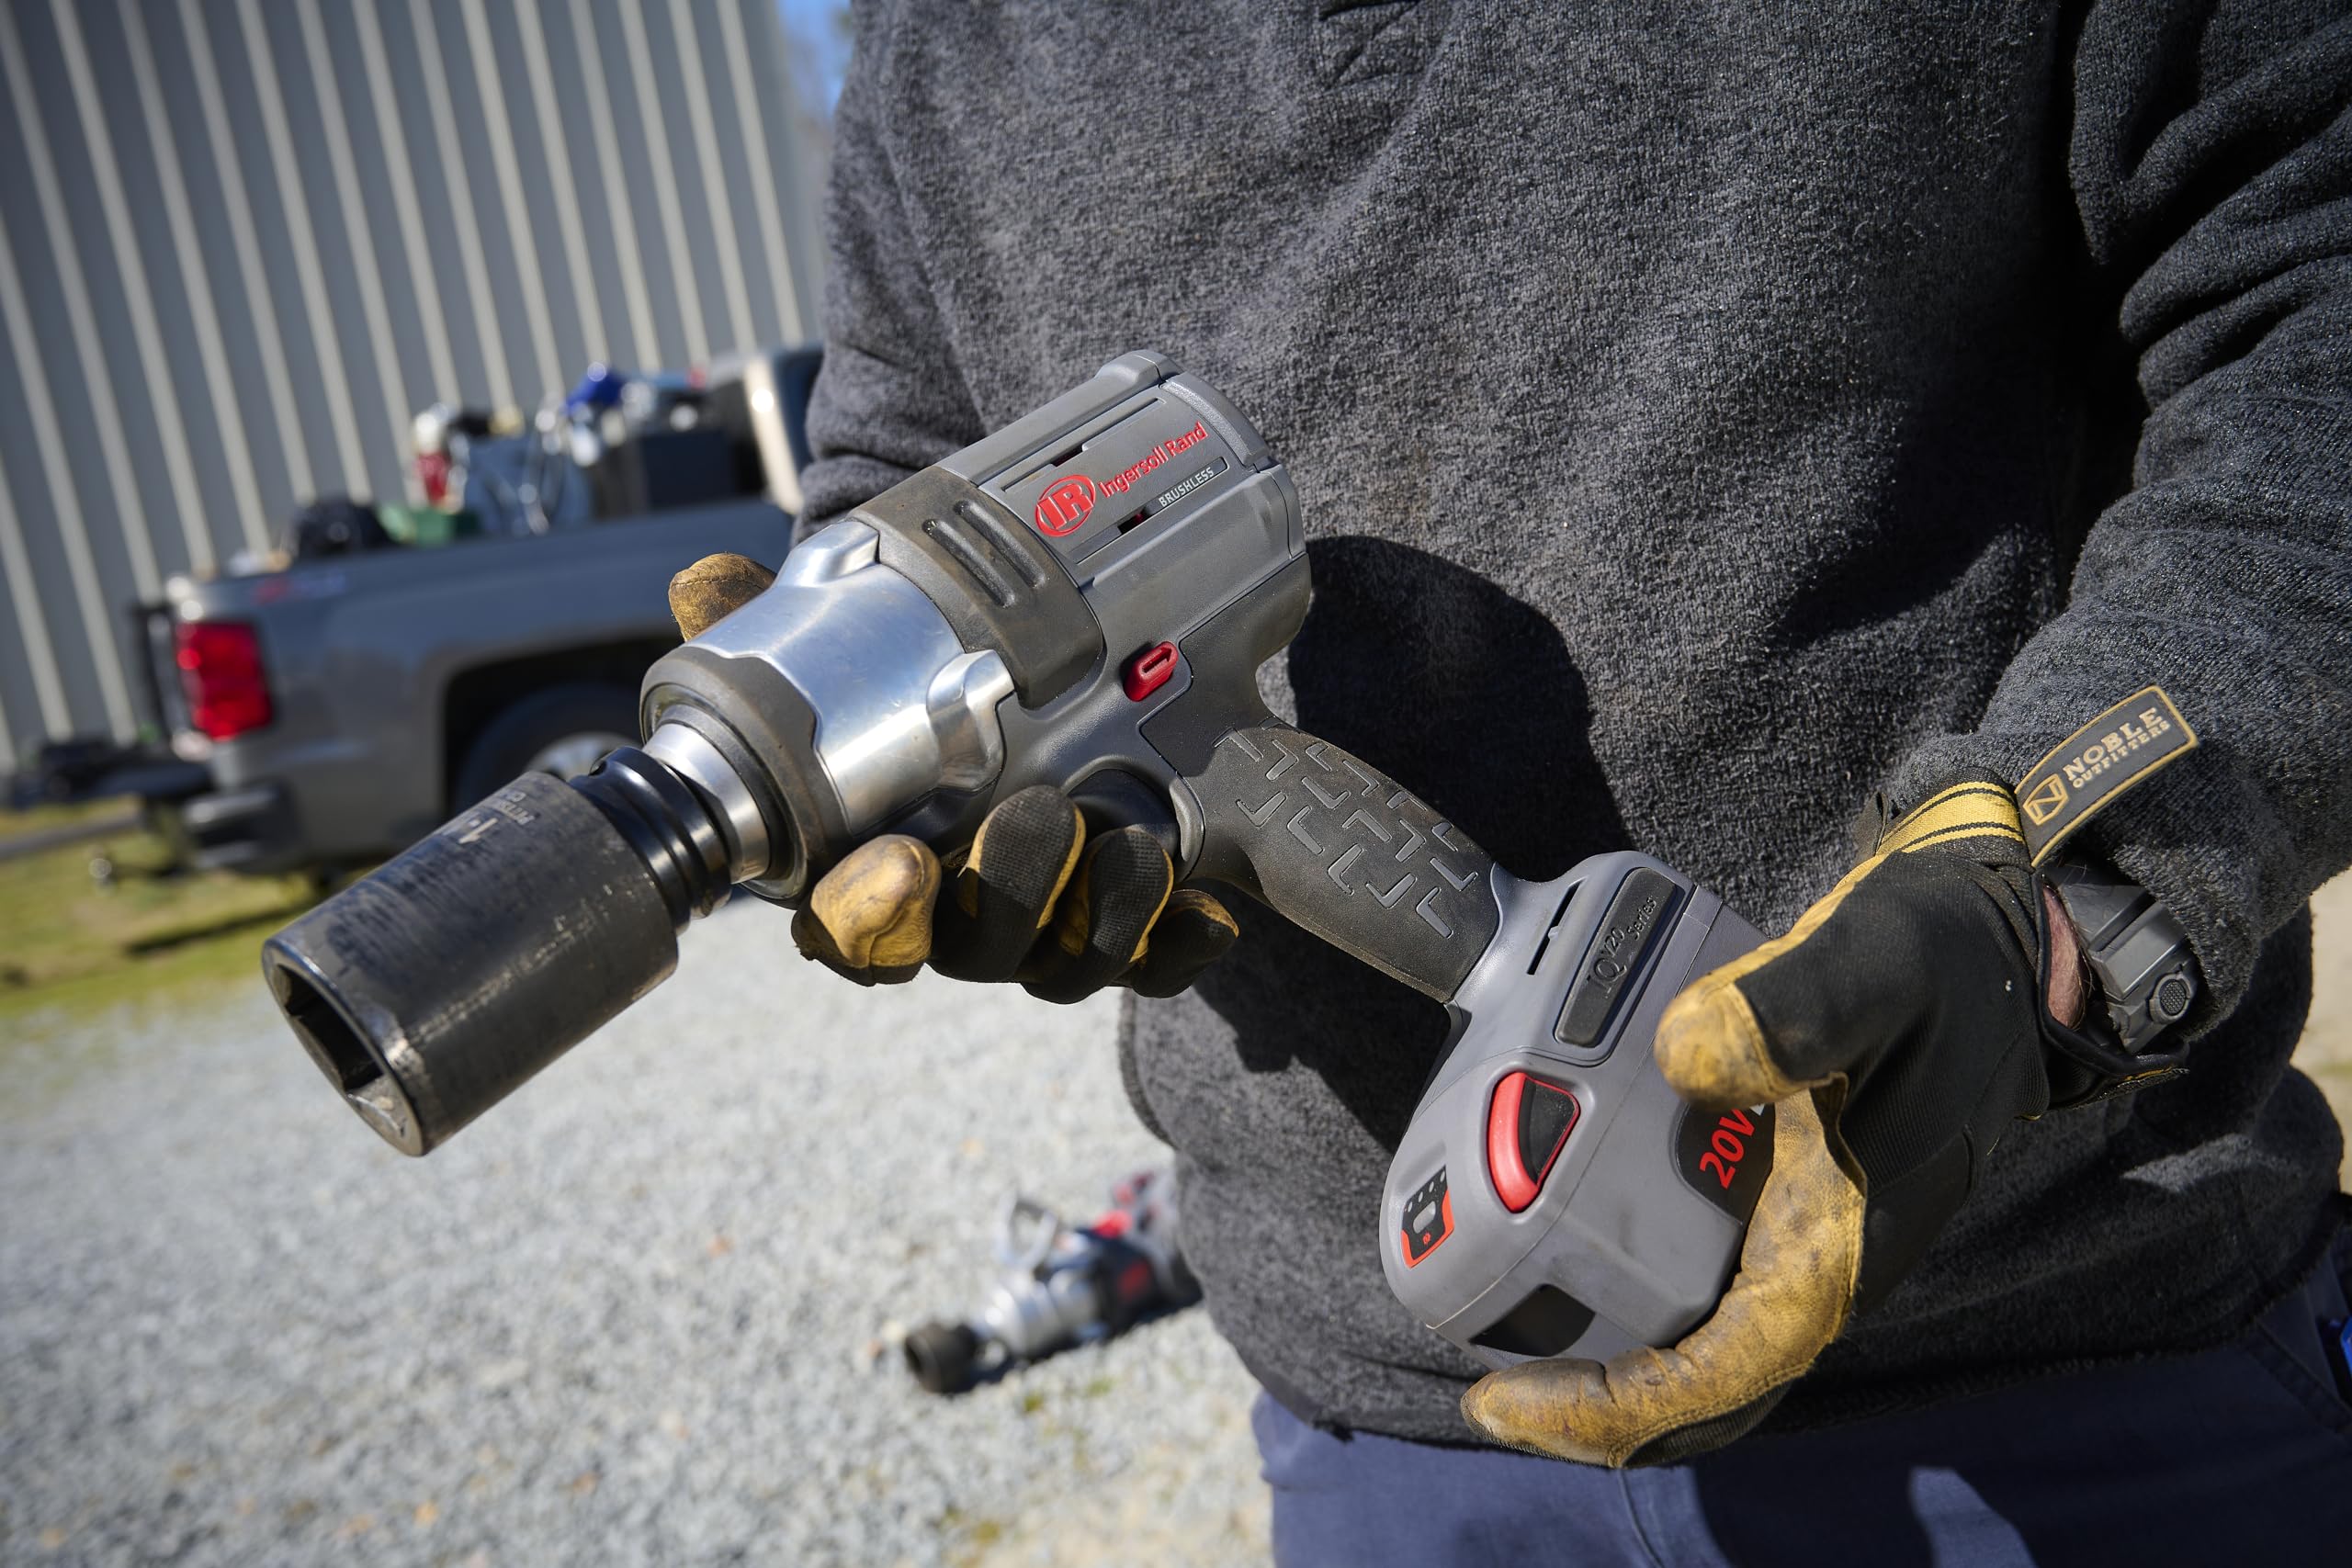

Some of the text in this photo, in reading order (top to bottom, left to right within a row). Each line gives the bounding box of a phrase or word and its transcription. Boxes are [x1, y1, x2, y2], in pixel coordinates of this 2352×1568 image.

[1097, 421, 1209, 499] Ingersoll Rand
[1158, 467, 1215, 507] BRUSHLESS
[1035, 480, 1094, 531] IR
[2063, 706, 2158, 781] NOBLE
[2073, 717, 2171, 789] OUTFITTERS
[1627, 897, 1657, 941] Series
[1700, 1108, 1756, 1190] 20V
